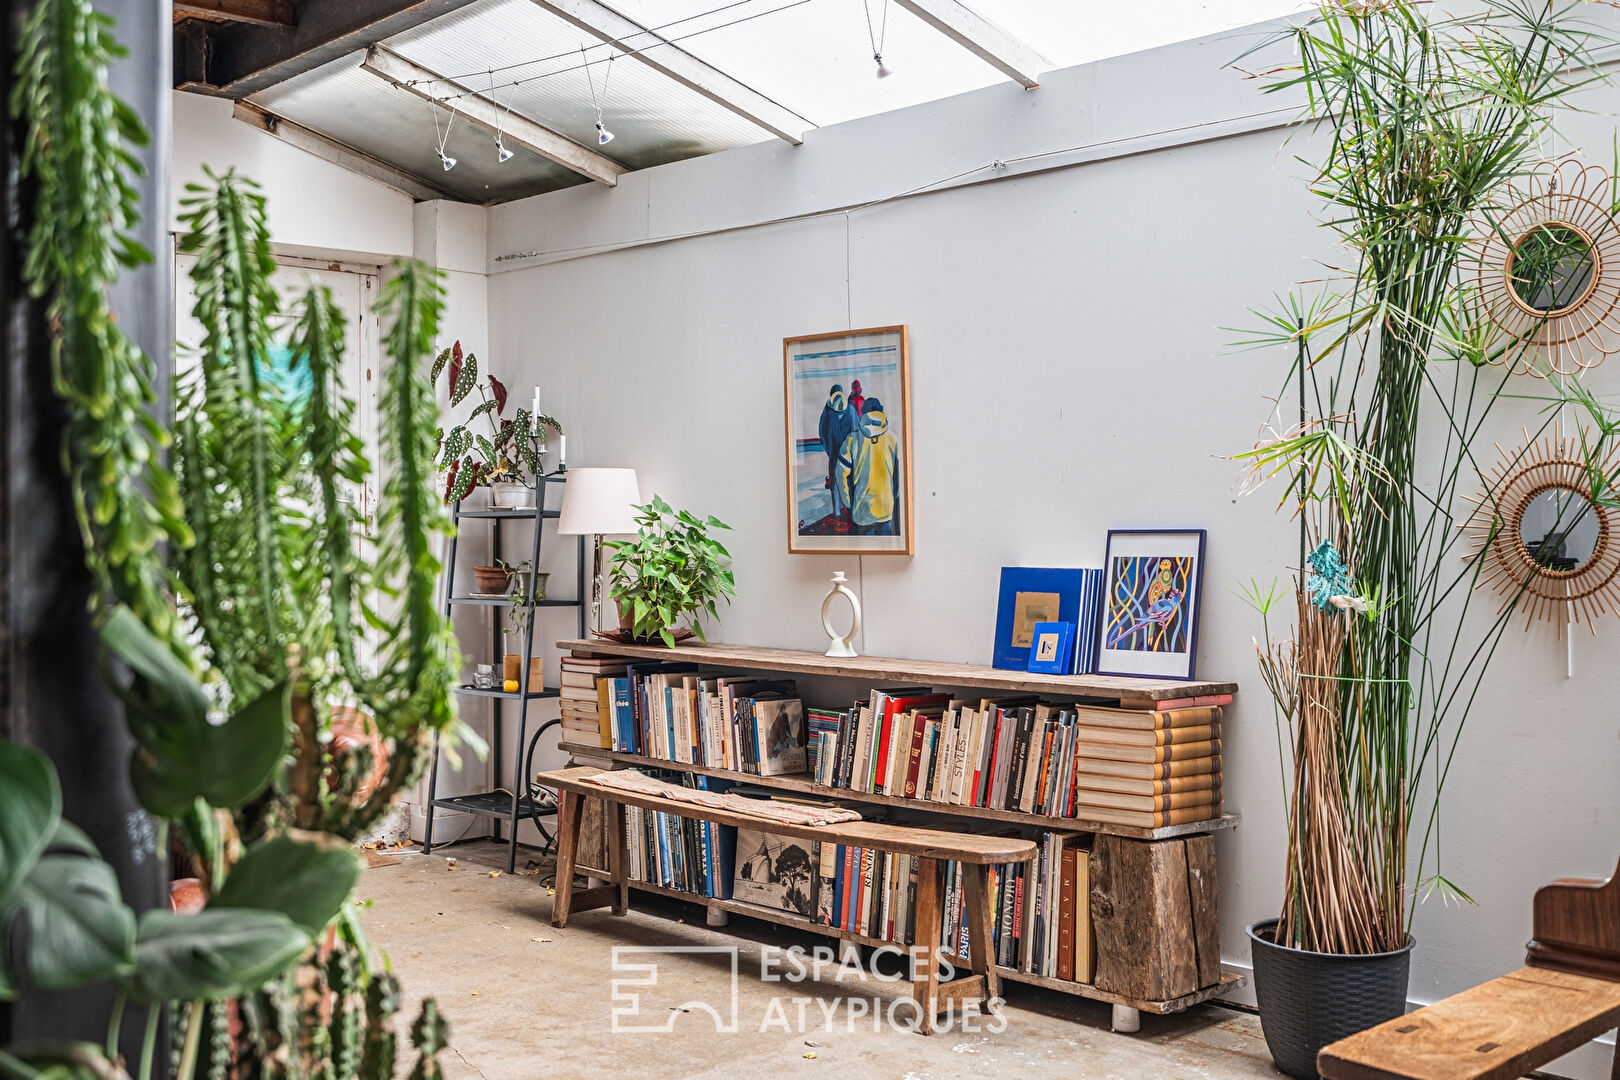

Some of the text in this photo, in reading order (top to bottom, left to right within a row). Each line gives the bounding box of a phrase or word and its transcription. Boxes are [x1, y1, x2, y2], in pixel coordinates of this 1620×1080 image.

[954, 739, 967, 778] STYLES
[865, 848, 874, 888] RENOIR
[1001, 876, 1016, 938] MONORY
[1062, 878, 1070, 951] MANET
[960, 926, 970, 961] PARIS
